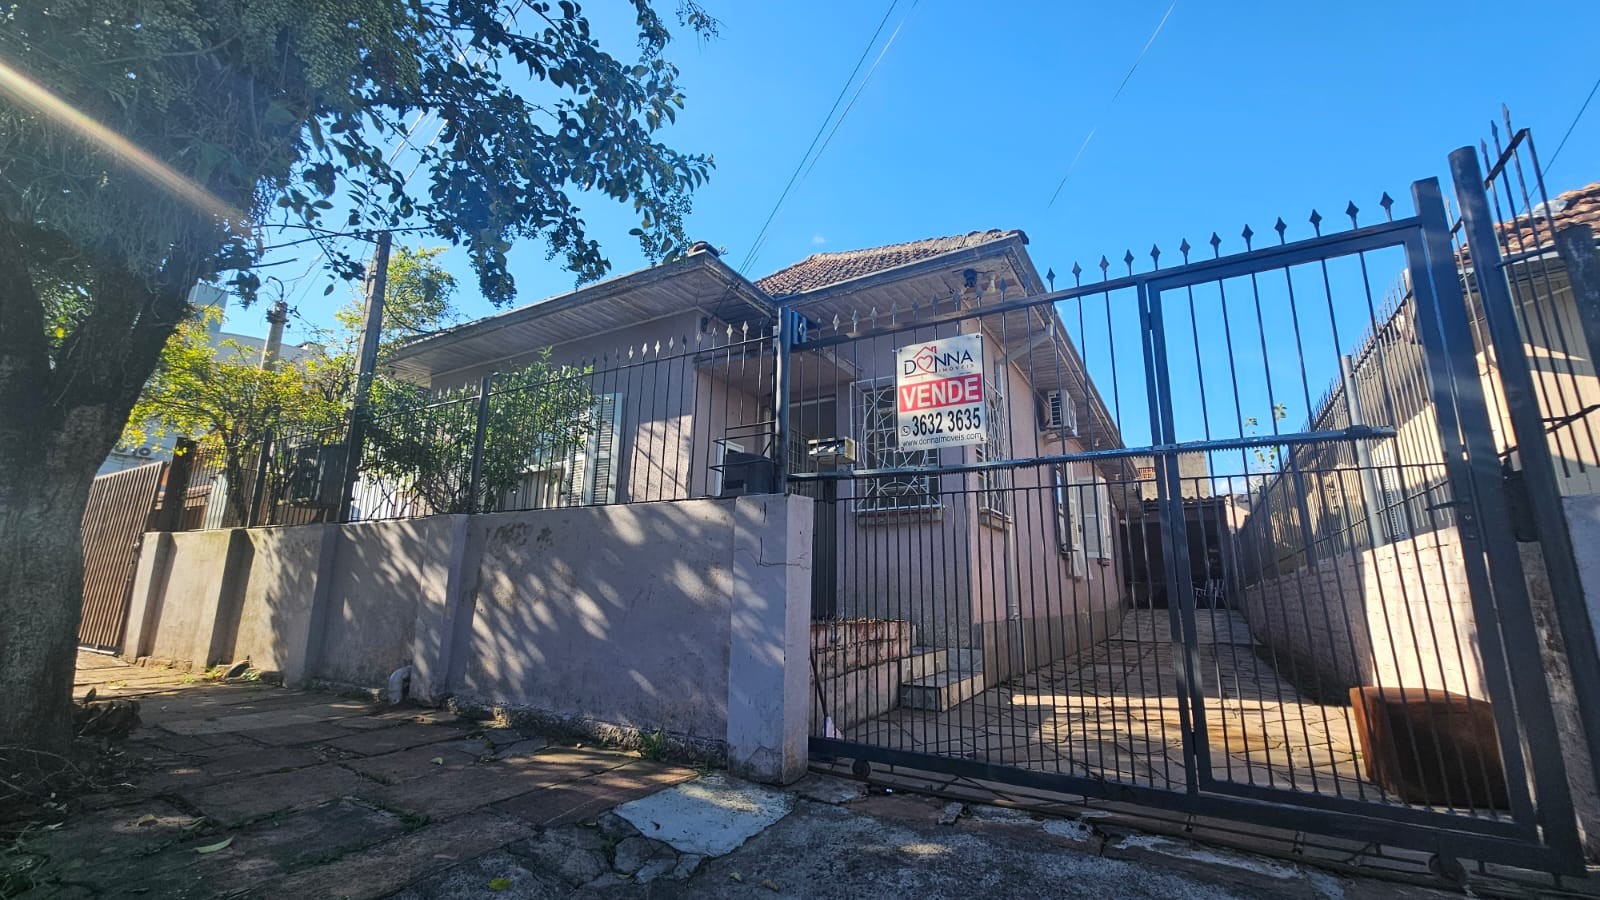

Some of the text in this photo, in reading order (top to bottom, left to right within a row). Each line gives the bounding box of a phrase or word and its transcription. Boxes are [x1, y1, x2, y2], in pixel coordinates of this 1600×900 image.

[902, 377, 979, 409] VENDE
[912, 407, 981, 437] 3632 3635
